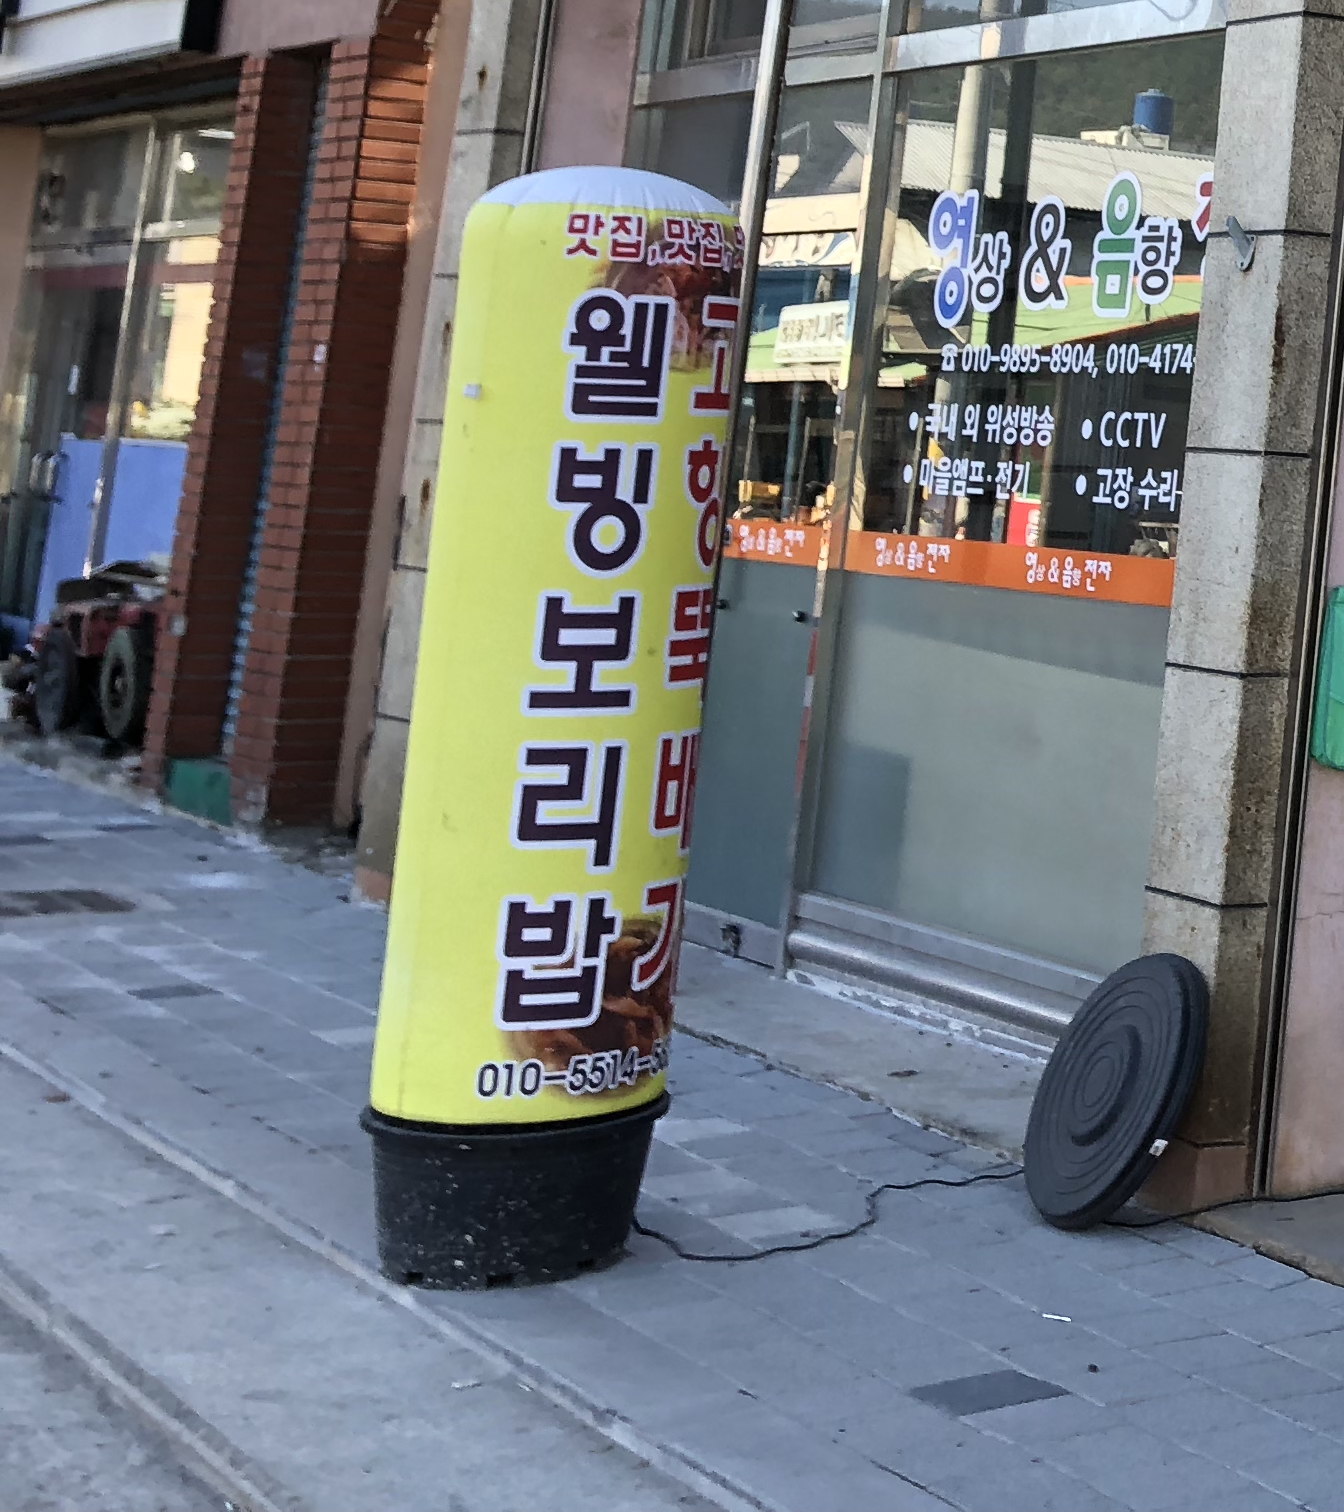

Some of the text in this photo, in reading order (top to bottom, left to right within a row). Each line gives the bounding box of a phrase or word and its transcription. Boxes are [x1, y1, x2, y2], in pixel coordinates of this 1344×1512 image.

[1100, 410, 1167, 449] CCTV
[1092, 467, 1179, 512] 고장 수리
